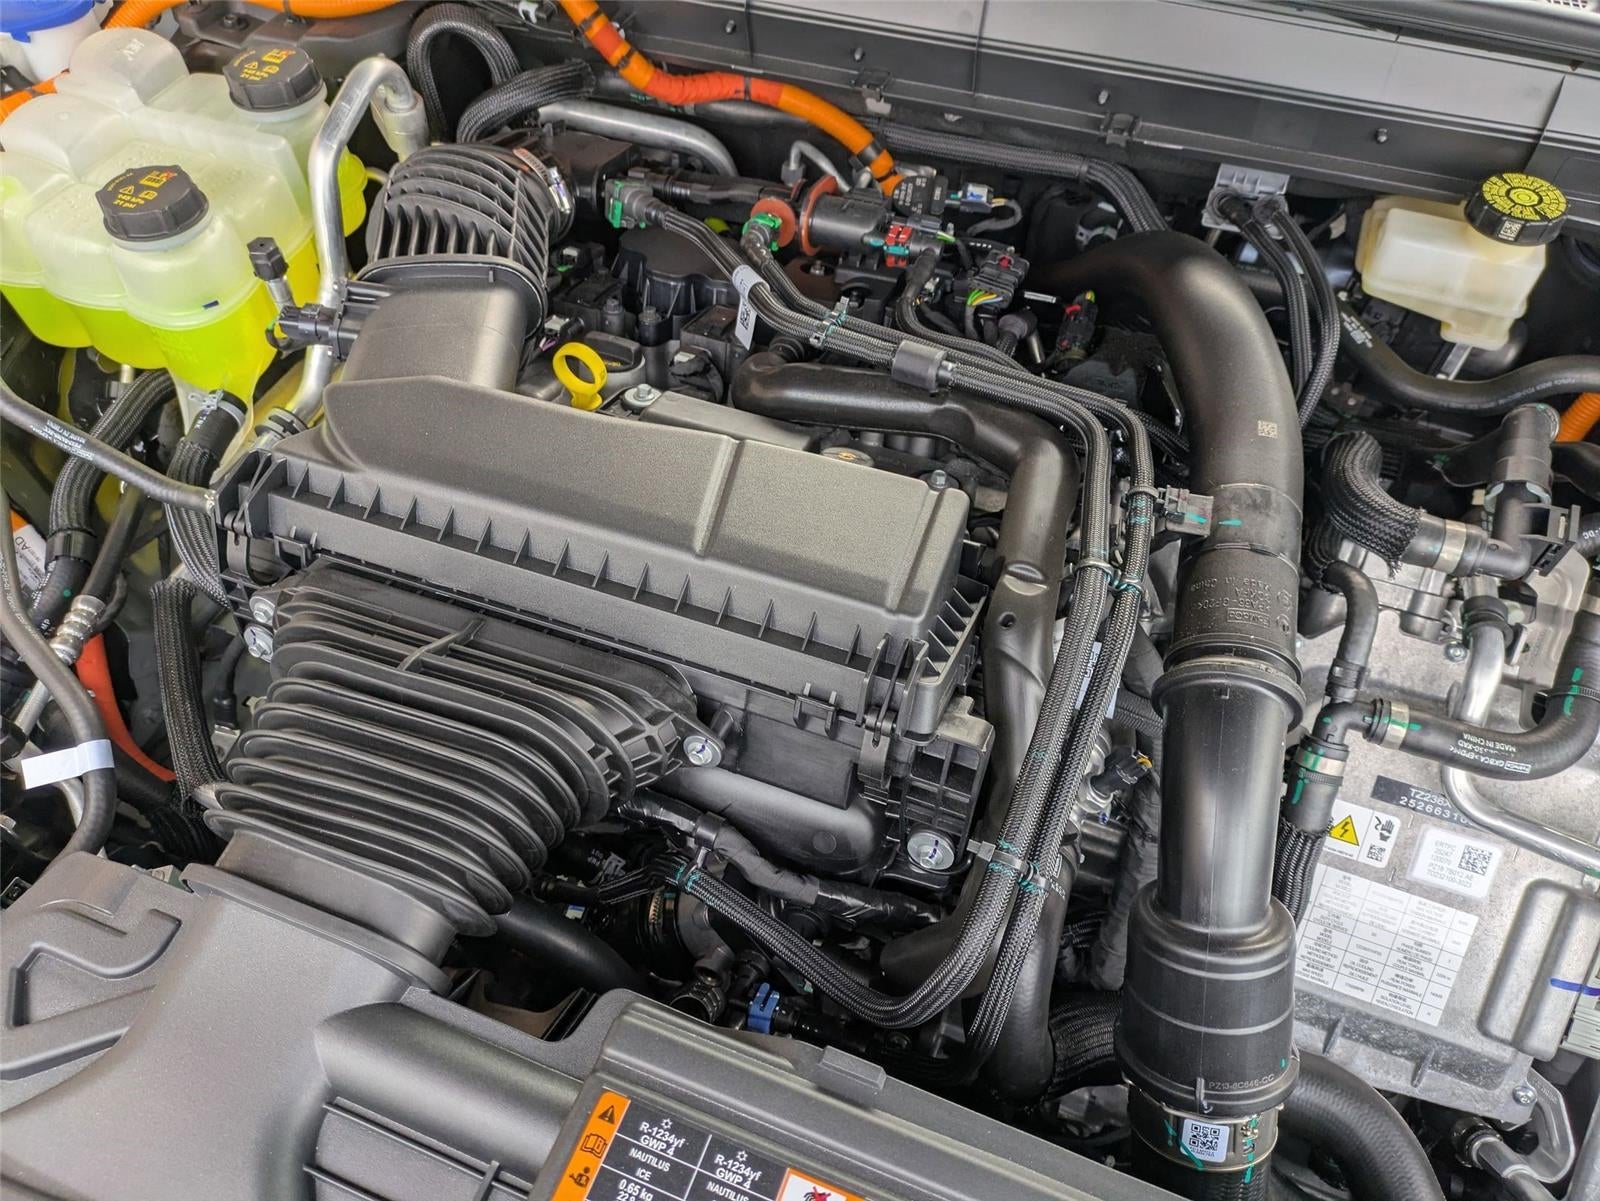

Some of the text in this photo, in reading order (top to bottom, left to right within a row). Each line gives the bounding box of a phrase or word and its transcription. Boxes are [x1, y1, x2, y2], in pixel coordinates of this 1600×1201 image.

[639, 1121, 686, 1148] R-1234yf
[640, 1135, 676, 1156] GWP 4
[628, 1148, 671, 1172] NAUTILUS
[714, 1154, 762, 1181] R-1234yf
[635, 1167, 652, 1182] ICE
[716, 1167, 752, 1189] GWP 4
[618, 1179, 654, 1201] 0.65 kg
